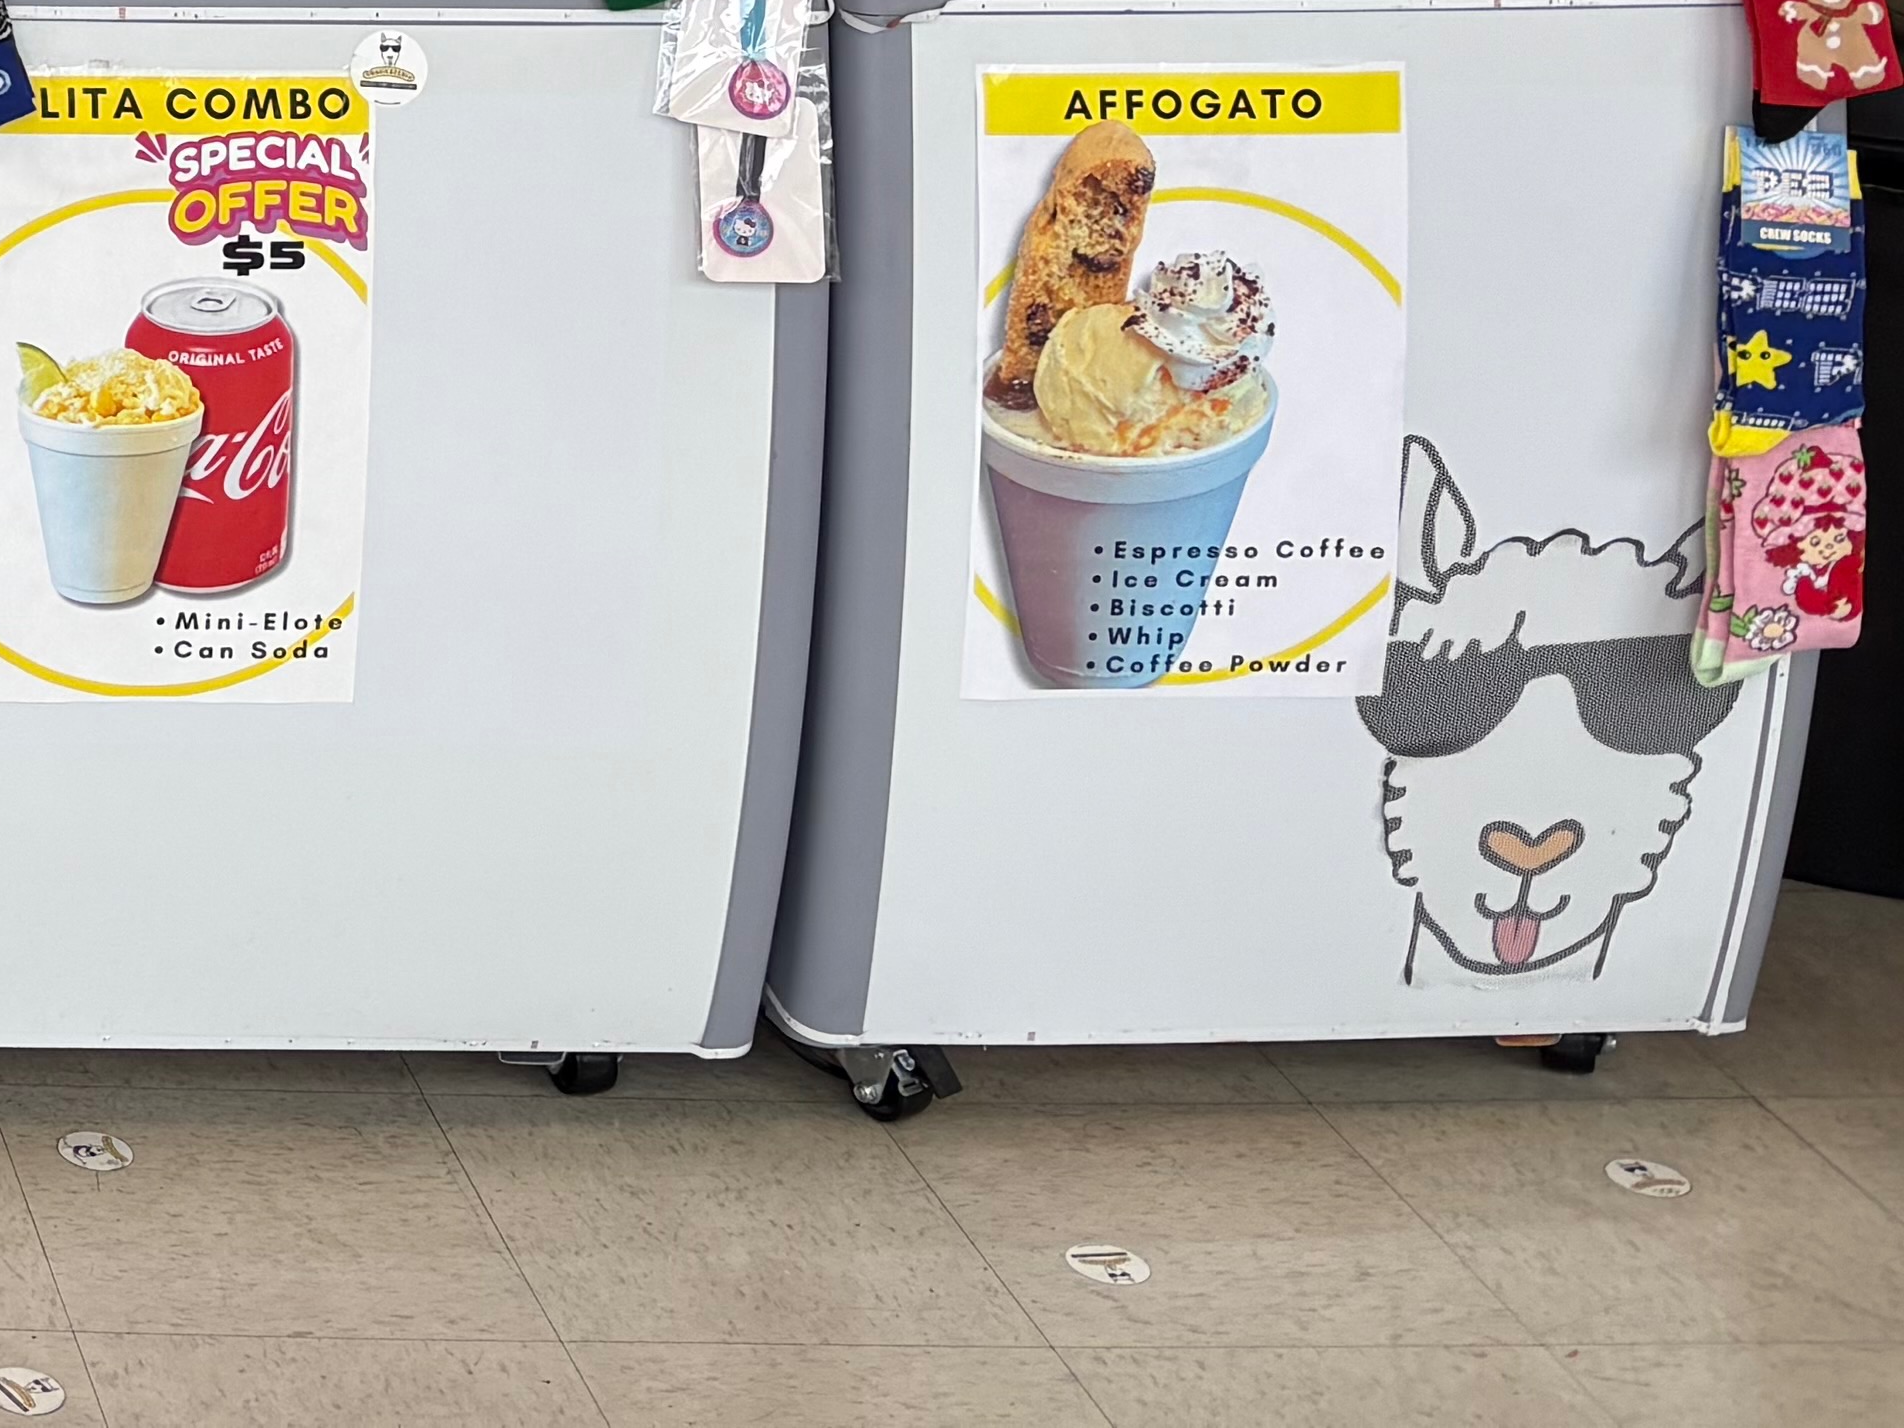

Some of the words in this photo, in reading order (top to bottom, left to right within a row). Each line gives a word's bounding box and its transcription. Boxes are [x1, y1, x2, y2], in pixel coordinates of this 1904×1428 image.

[40, 87, 144, 121] LITA
[180, 86, 352, 121] COMBO
[1064, 87, 1324, 122] AFFOGATO
[174, 132, 359, 184] SPECIAL
[173, 178, 360, 234] OFFER
[1792, 228, 1833, 245] SOCKS
[221, 234, 307, 277] $5
[167, 346, 246, 368] ORIGINAL
[247, 337, 285, 361] TASTE
[1113, 539, 1260, 562] Espresso
[1275, 539, 1386, 560] Coffee
[1111, 570, 1158, 589] Ice
[1174, 570, 1279, 589] Cream
[1109, 598, 1236, 617] Biscotti
[175, 610, 344, 632] Mini-Elote
[1108, 626, 1185, 648] Whip
[173, 640, 234, 661] Can
[250, 640, 330, 661] Soda
[1105, 654, 1214, 675] Coffee
[1228, 654, 1348, 675] Powder
